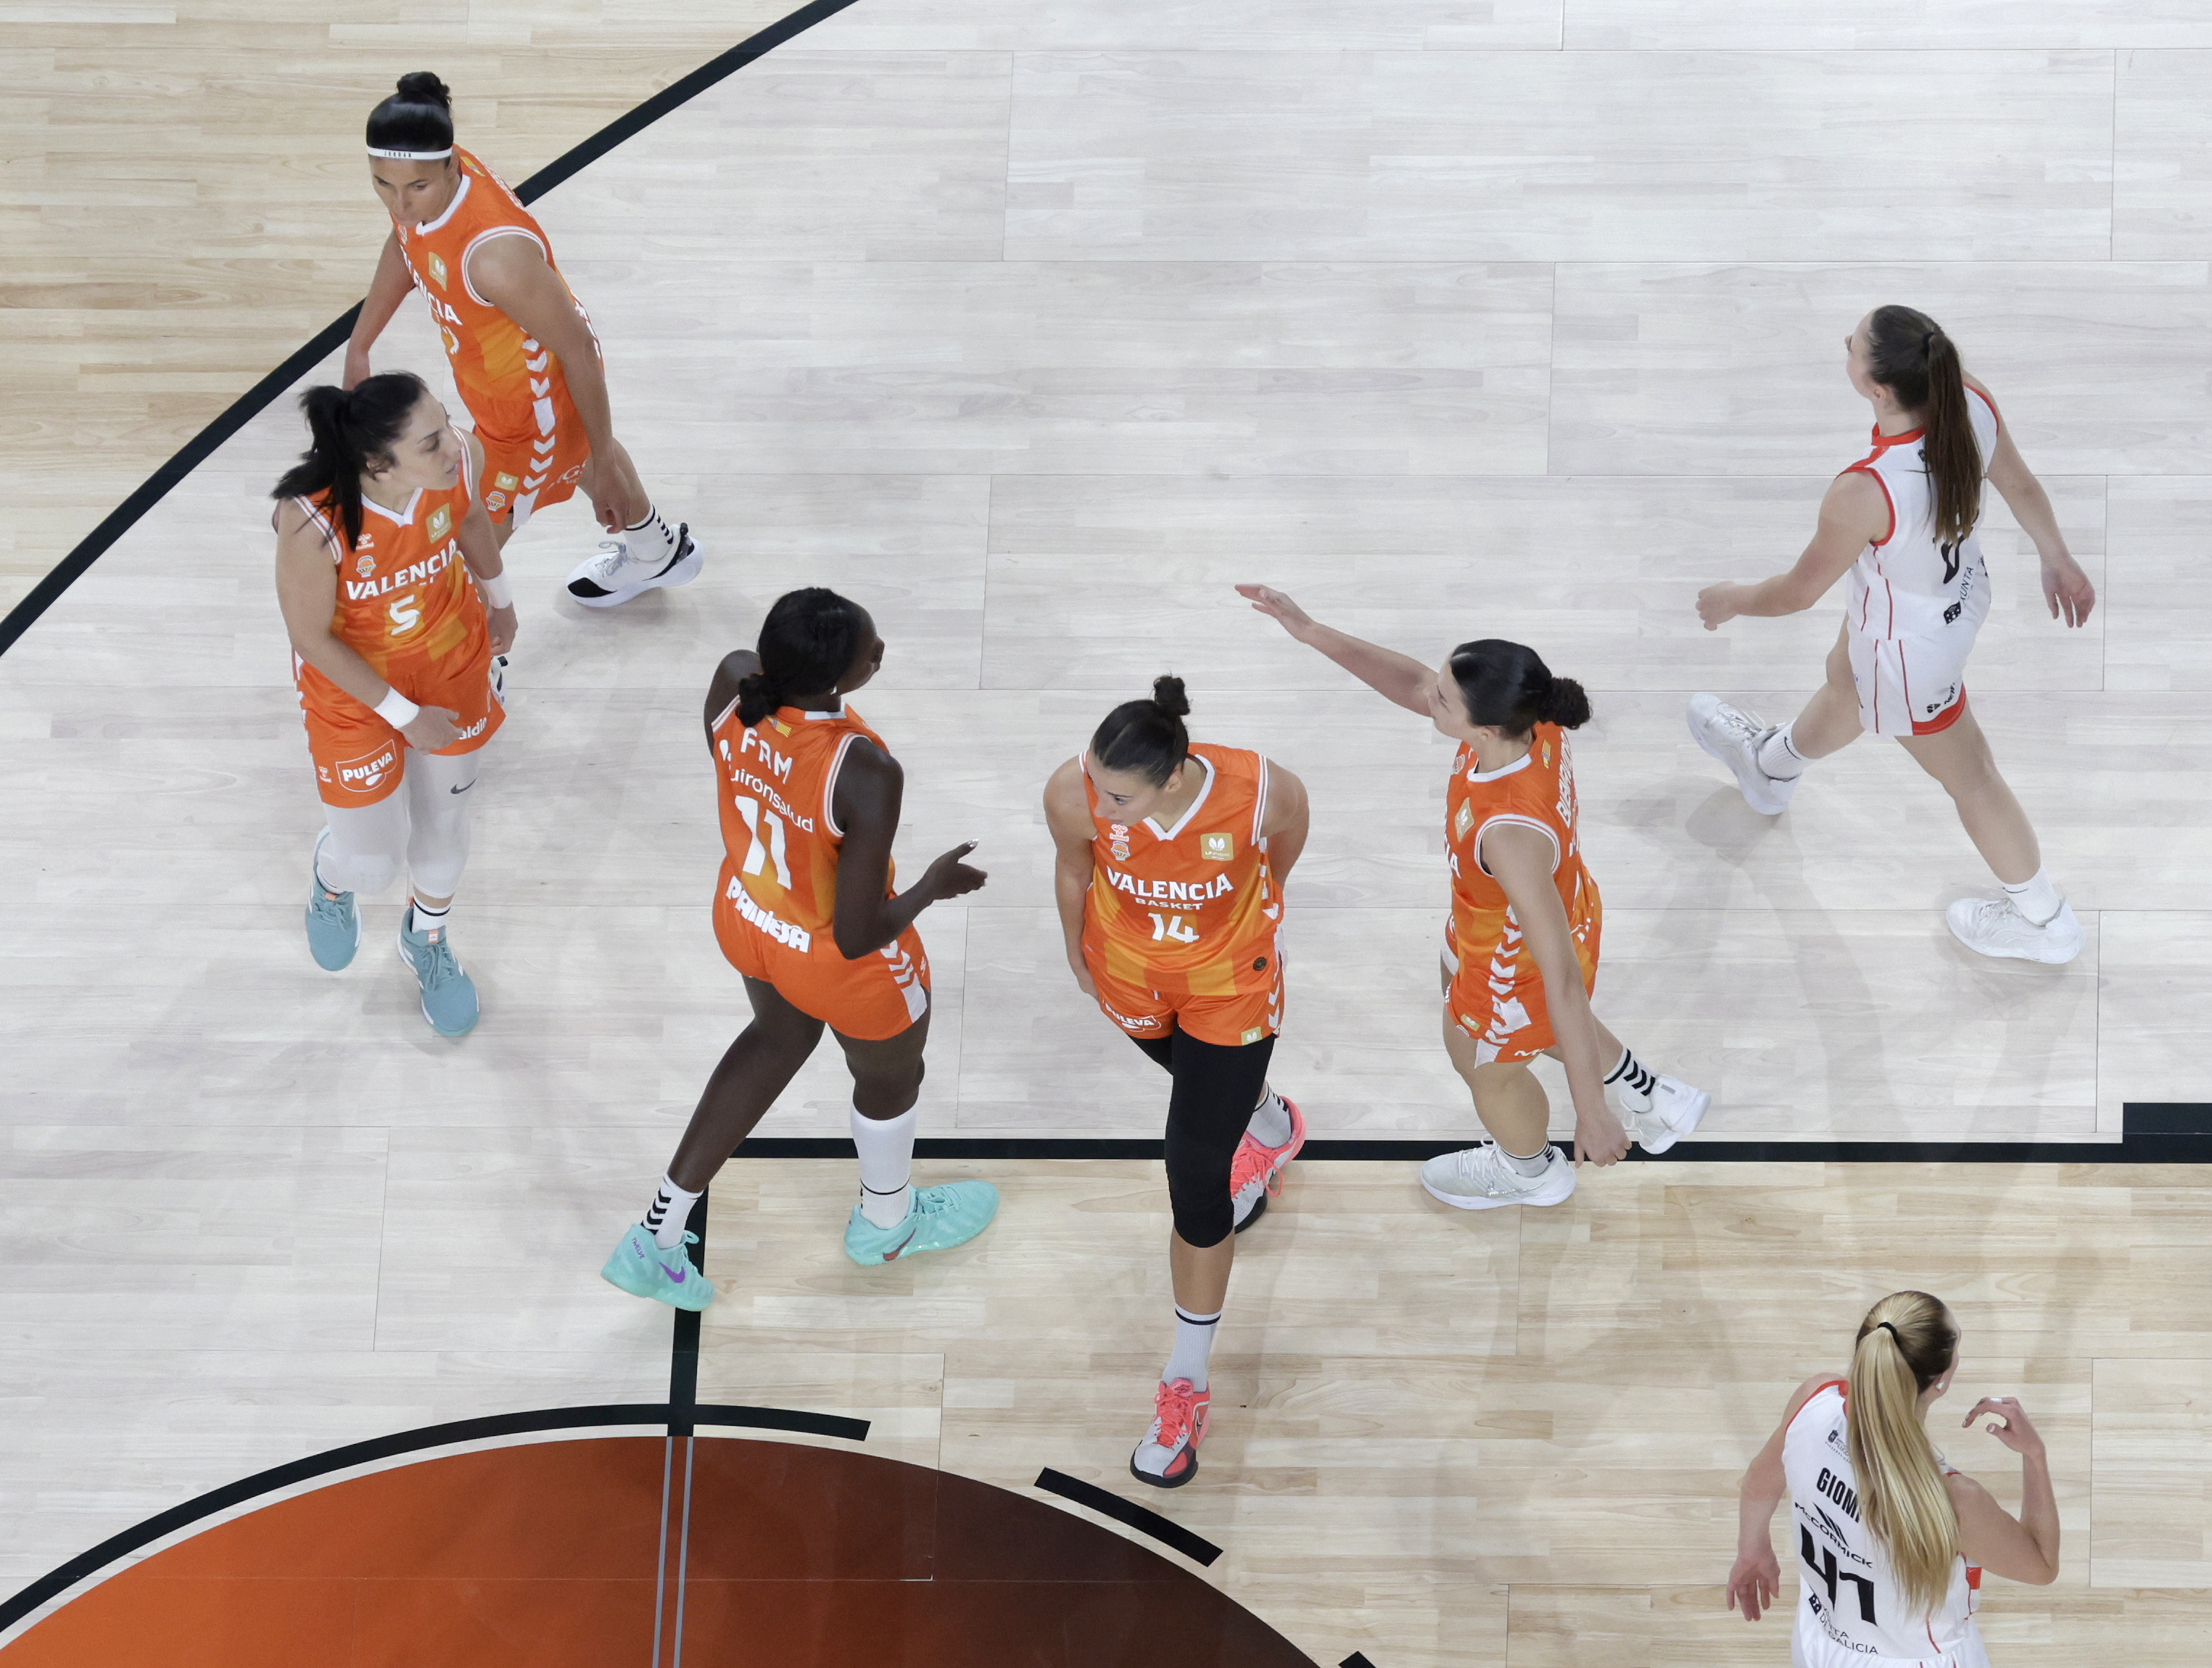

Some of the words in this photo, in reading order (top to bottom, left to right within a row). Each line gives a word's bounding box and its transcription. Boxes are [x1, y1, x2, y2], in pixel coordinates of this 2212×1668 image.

[345, 537, 458, 600] VALENCIA
[388, 594, 421, 636] 5
[342, 751, 394, 782] PULEVA
[740, 727, 793, 785] FAM
[730, 768, 814, 833] uirónsalud
[734, 795, 793, 891] 11
[1106, 865, 1234, 901] VALENCIA
[1134, 896, 1203, 911] BASKET
[1147, 912, 1200, 944] 14
[1816, 1466, 1862, 1524] GIOM
[1828, 1630, 1878, 1655] GALICIA
